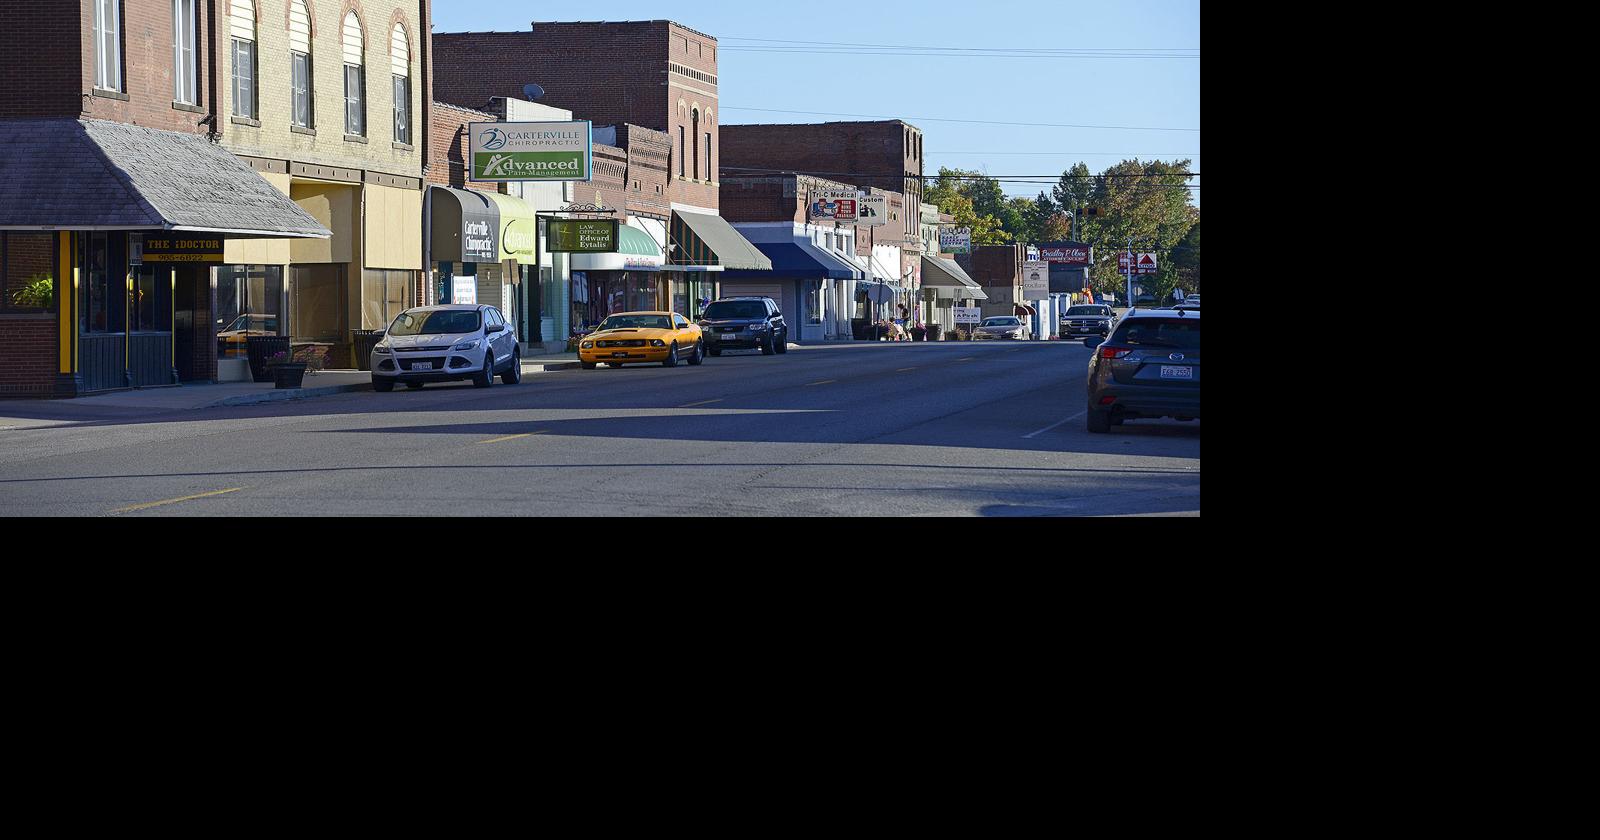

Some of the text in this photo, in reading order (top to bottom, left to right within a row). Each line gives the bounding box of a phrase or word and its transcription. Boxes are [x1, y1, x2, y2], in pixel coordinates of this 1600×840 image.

[507, 131, 580, 140] CARTERVILLE
[482, 154, 580, 176] Advanced
[464, 221, 489, 236] Carterville
[148, 240, 170, 249] THE
[465, 236, 492, 254] Chiropractic
[580, 241, 607, 249] Eytalis
